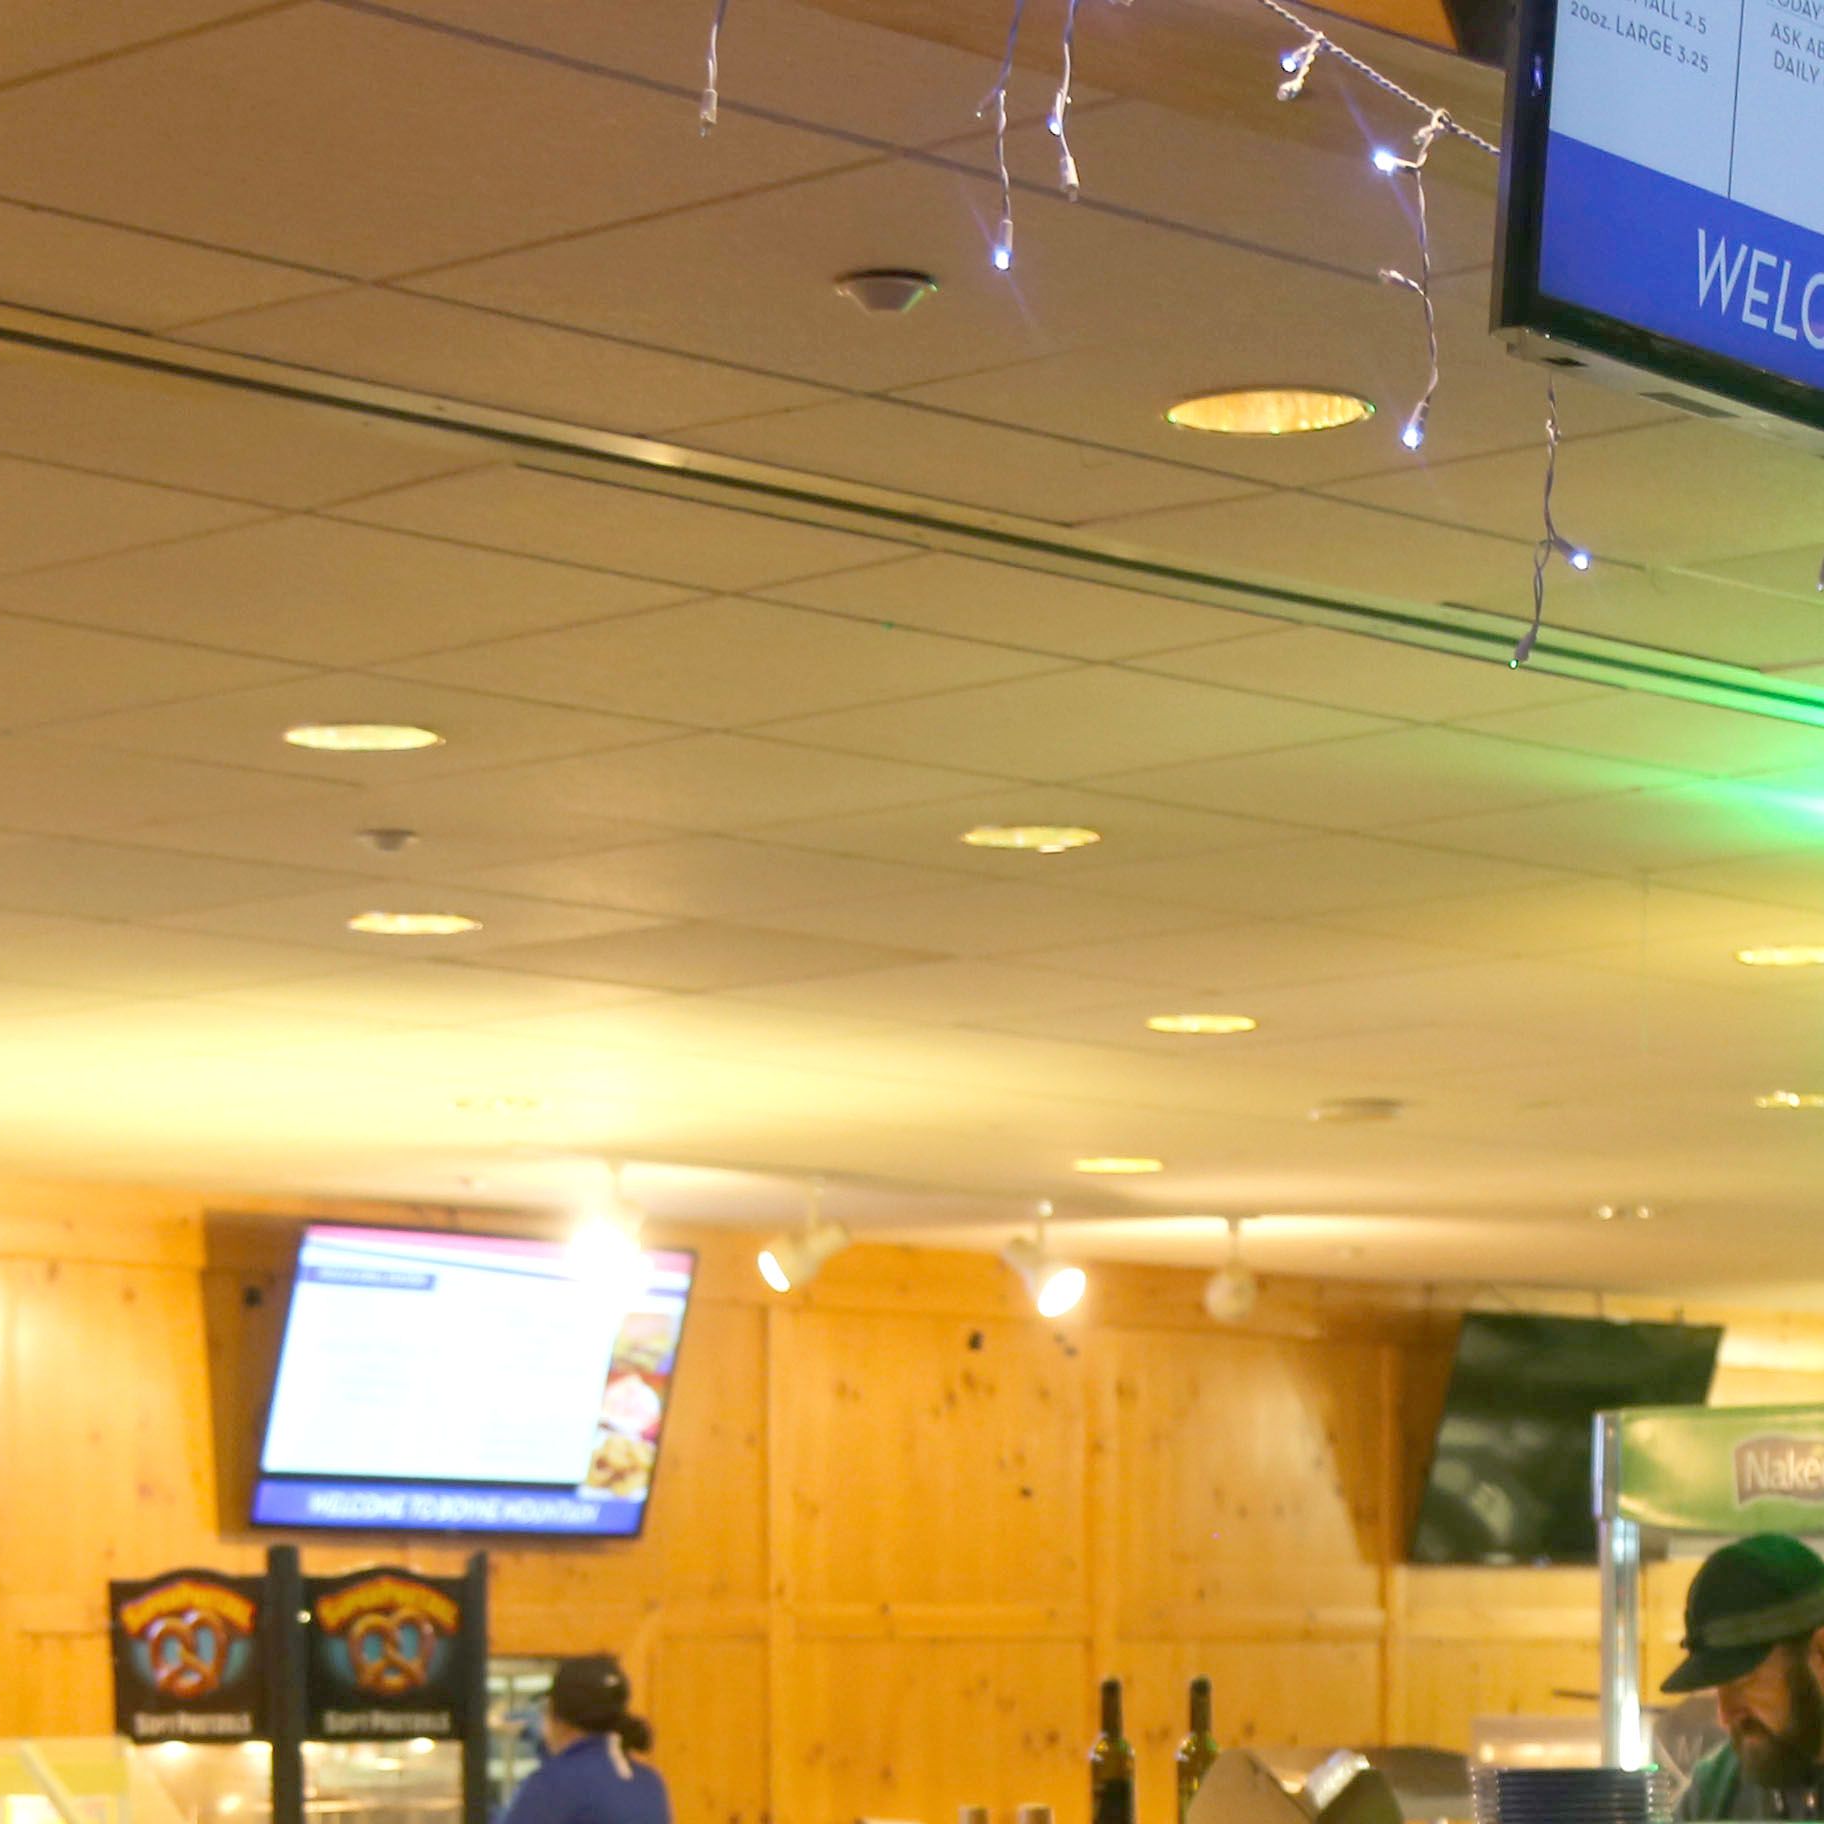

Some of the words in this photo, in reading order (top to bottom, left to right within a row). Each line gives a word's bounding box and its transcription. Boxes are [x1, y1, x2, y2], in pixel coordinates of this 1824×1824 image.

[1685, 10, 1706, 34] 2.5
[1770, 22, 1801, 49] ASK
[1616, 15, 1672, 56] LARGE
[1676, 46, 1709, 73] 3.25
[1774, 50, 1820, 84] DAILY
